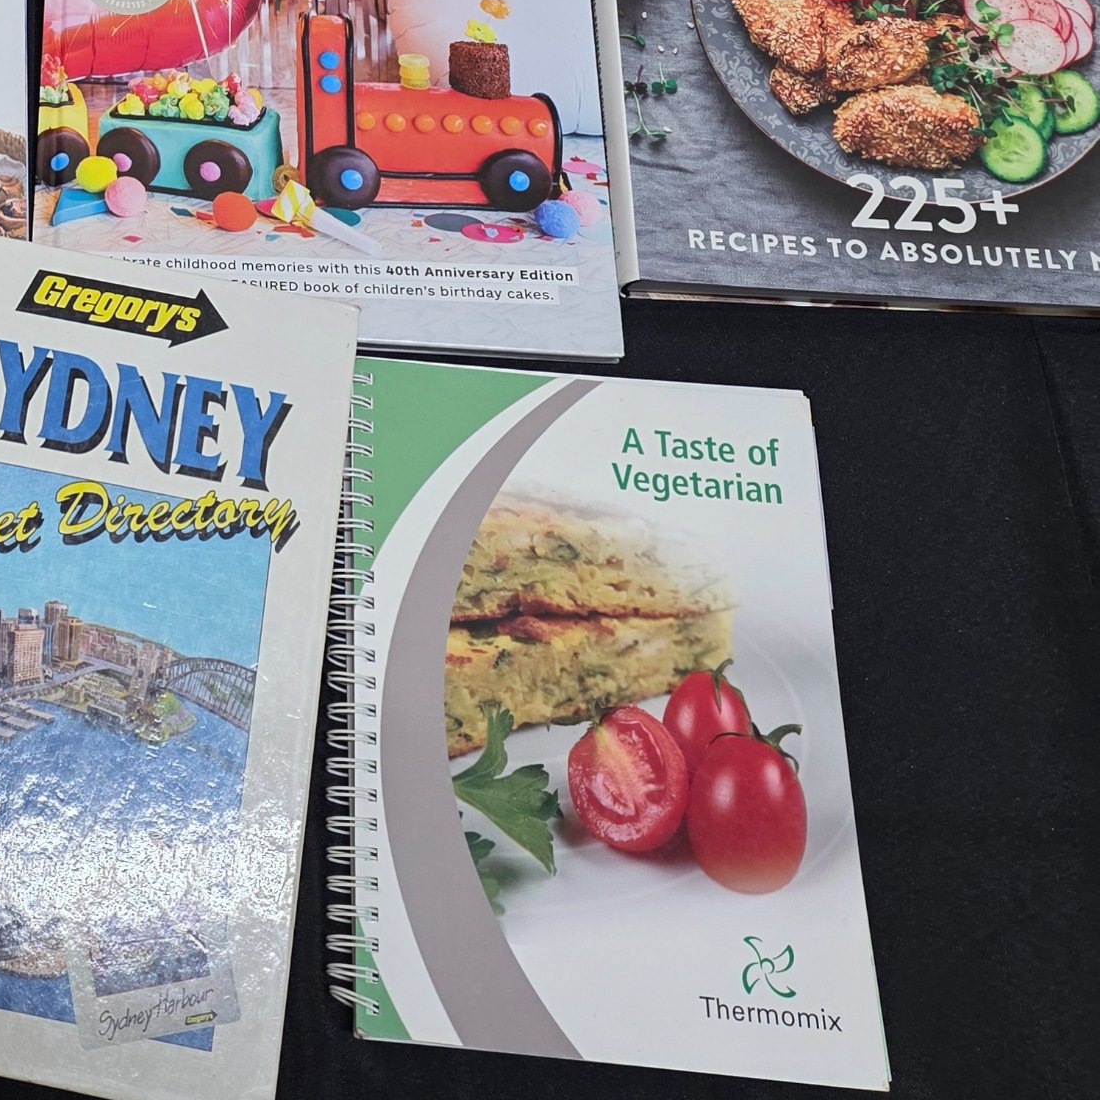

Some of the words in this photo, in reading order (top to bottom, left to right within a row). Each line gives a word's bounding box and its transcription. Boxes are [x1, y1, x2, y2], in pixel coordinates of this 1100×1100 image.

[846, 173, 1019, 235] 225+
[166, 257, 237, 271] childhood
[242, 261, 313, 274] memories
[318, 261, 349, 274] with
[353, 261, 381, 275] this
[385, 264, 420, 278] 40th
[424, 266, 516, 283] Anniversary
[520, 268, 574, 282] Edition
[687, 229, 817, 258] RECIPES
[826, 237, 868, 260] TO
[879, 240, 1078, 271] ABSOLUTELY
[33, 274, 202, 334] Gregory's
[303, 281, 339, 294] book
[344, 282, 359, 295] of
[363, 283, 436, 298] children's
[440, 285, 502, 301] birthday
[506, 288, 555, 301] cakes.
[621, 427, 644, 455] A
[654, 429, 736, 463] Taste
[748, 438, 779, 467] of
[611, 462, 783, 504] Vegetarian
[55, 480, 301, 554] Directory
[99, 1007, 154, 1041] Sydney
[150, 988, 214, 1018] Harbour
[699, 995, 843, 1032] Thermomix
